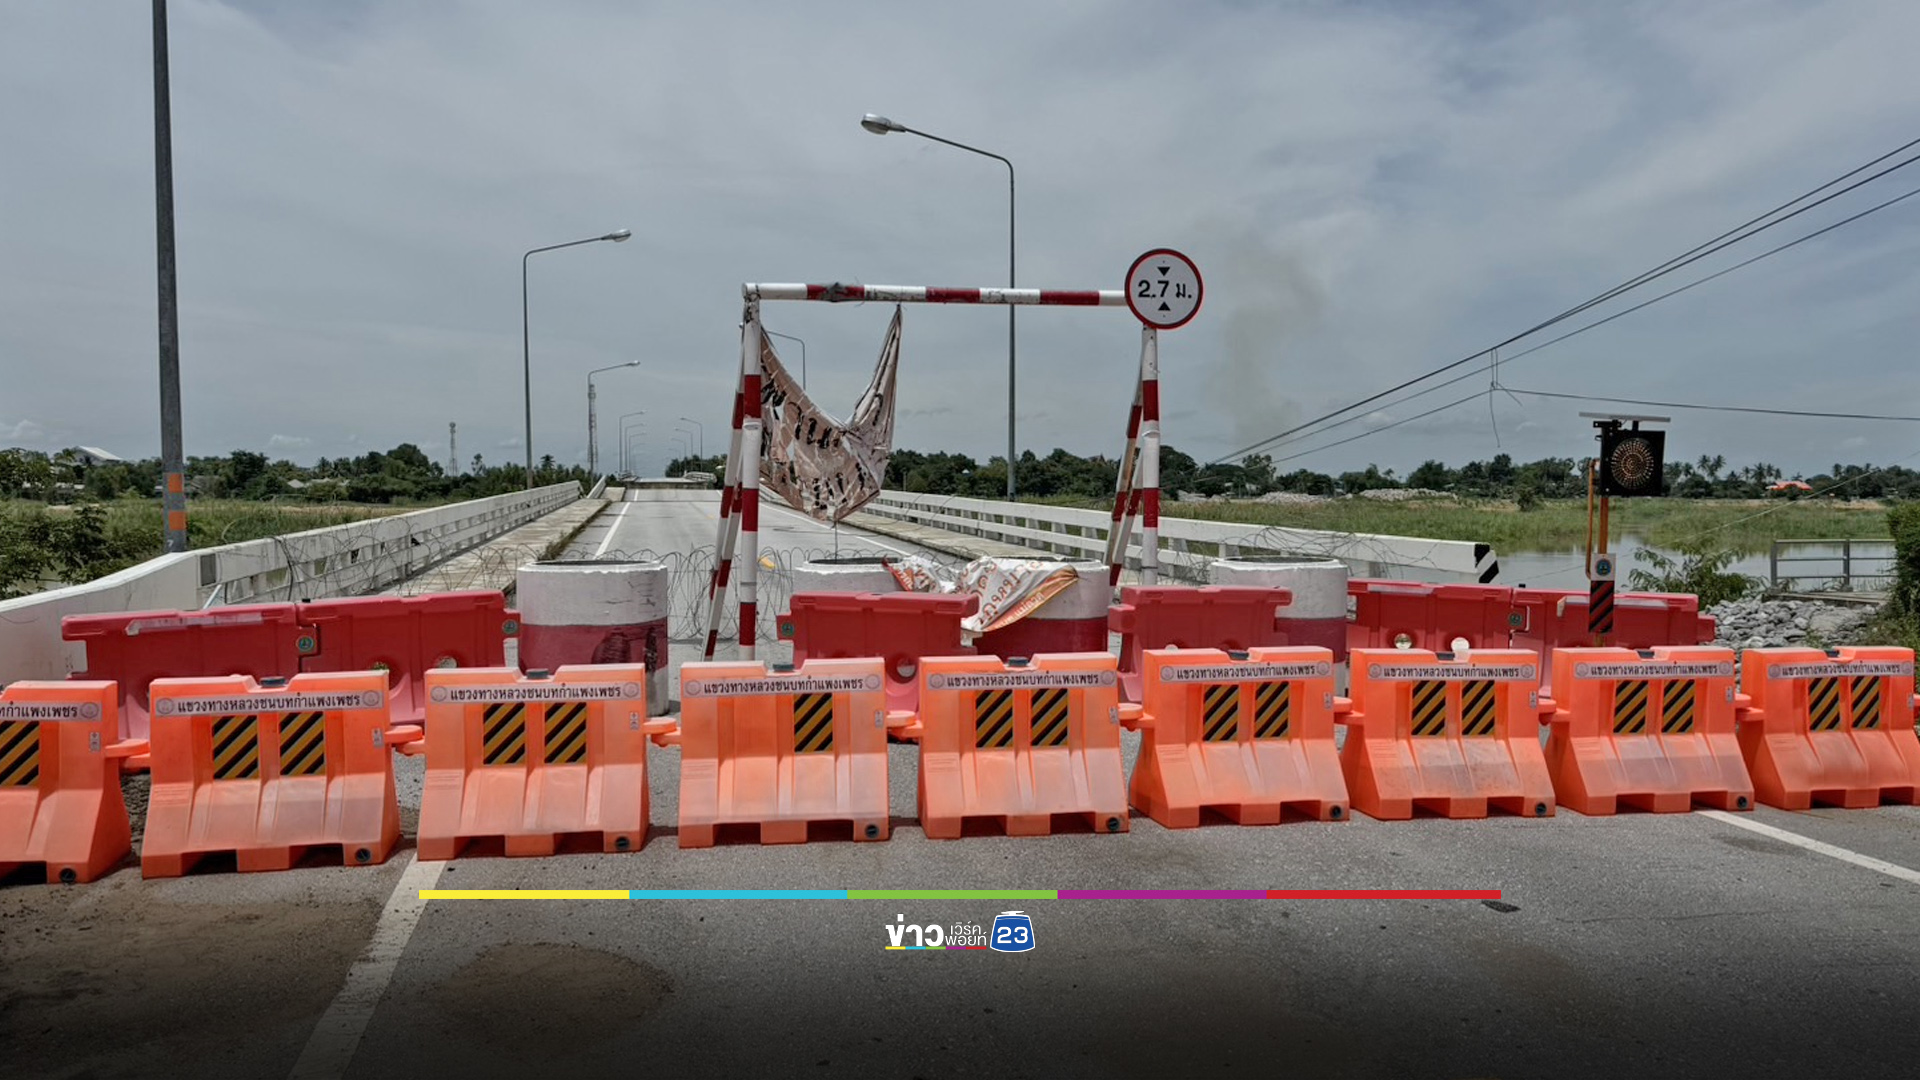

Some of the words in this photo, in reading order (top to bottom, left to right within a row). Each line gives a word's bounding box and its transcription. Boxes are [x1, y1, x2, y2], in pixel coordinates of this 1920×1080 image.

[1138, 279, 1170, 299] 2.7
[1175, 283, 1192, 299] ม.
[947, 670, 1099, 688] แขวงทางหลวงชนบทกำแพงเพชร
[1177, 662, 1316, 680] แขวงทางหลวงชนบทกำแพงเพชร
[1384, 663, 1519, 678] แขวงทางหลวงชนบทกำแพงเพชร
[451, 683, 621, 700] แขวงทางหลวงชนบทกำแพงเพชร
[704, 675, 864, 694] แขวงทางหลวงชนบทกำแพงเพชร
[178, 692, 361, 713] แขวงทางหลวงชนบทกำแพงเพชร
